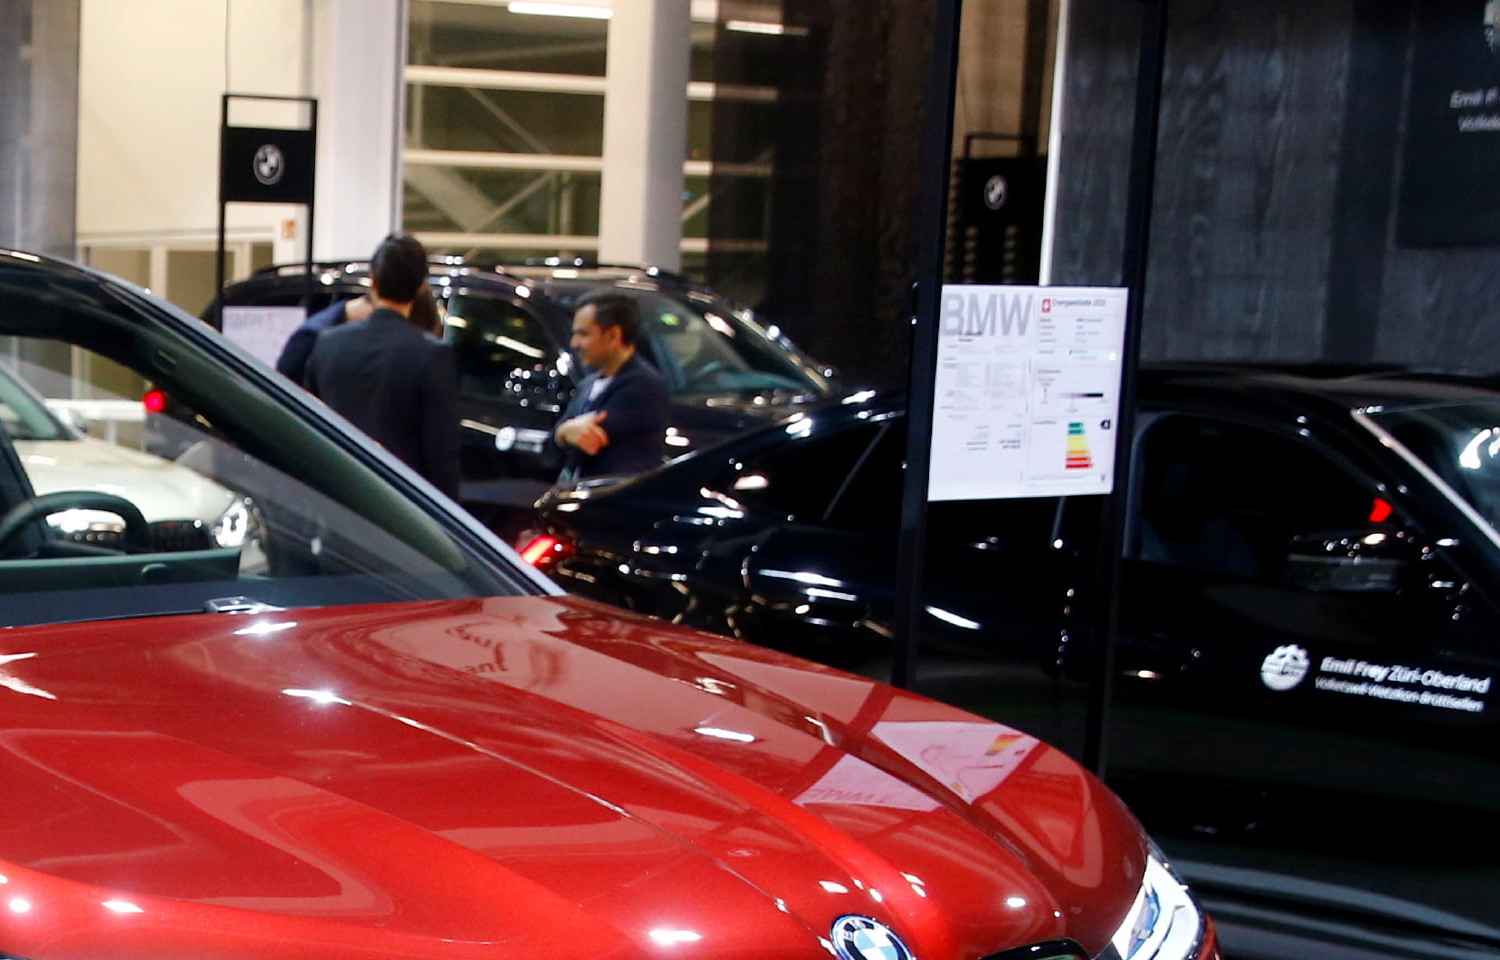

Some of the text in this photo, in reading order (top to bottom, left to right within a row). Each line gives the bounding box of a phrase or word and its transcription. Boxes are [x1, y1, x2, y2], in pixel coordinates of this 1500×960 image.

[941, 293, 1033, 336] BMW
[1320, 656, 1357, 676] Emil
[1353, 660, 1391, 683] Frey
[1388, 664, 1491, 694] Züri-Oberland
